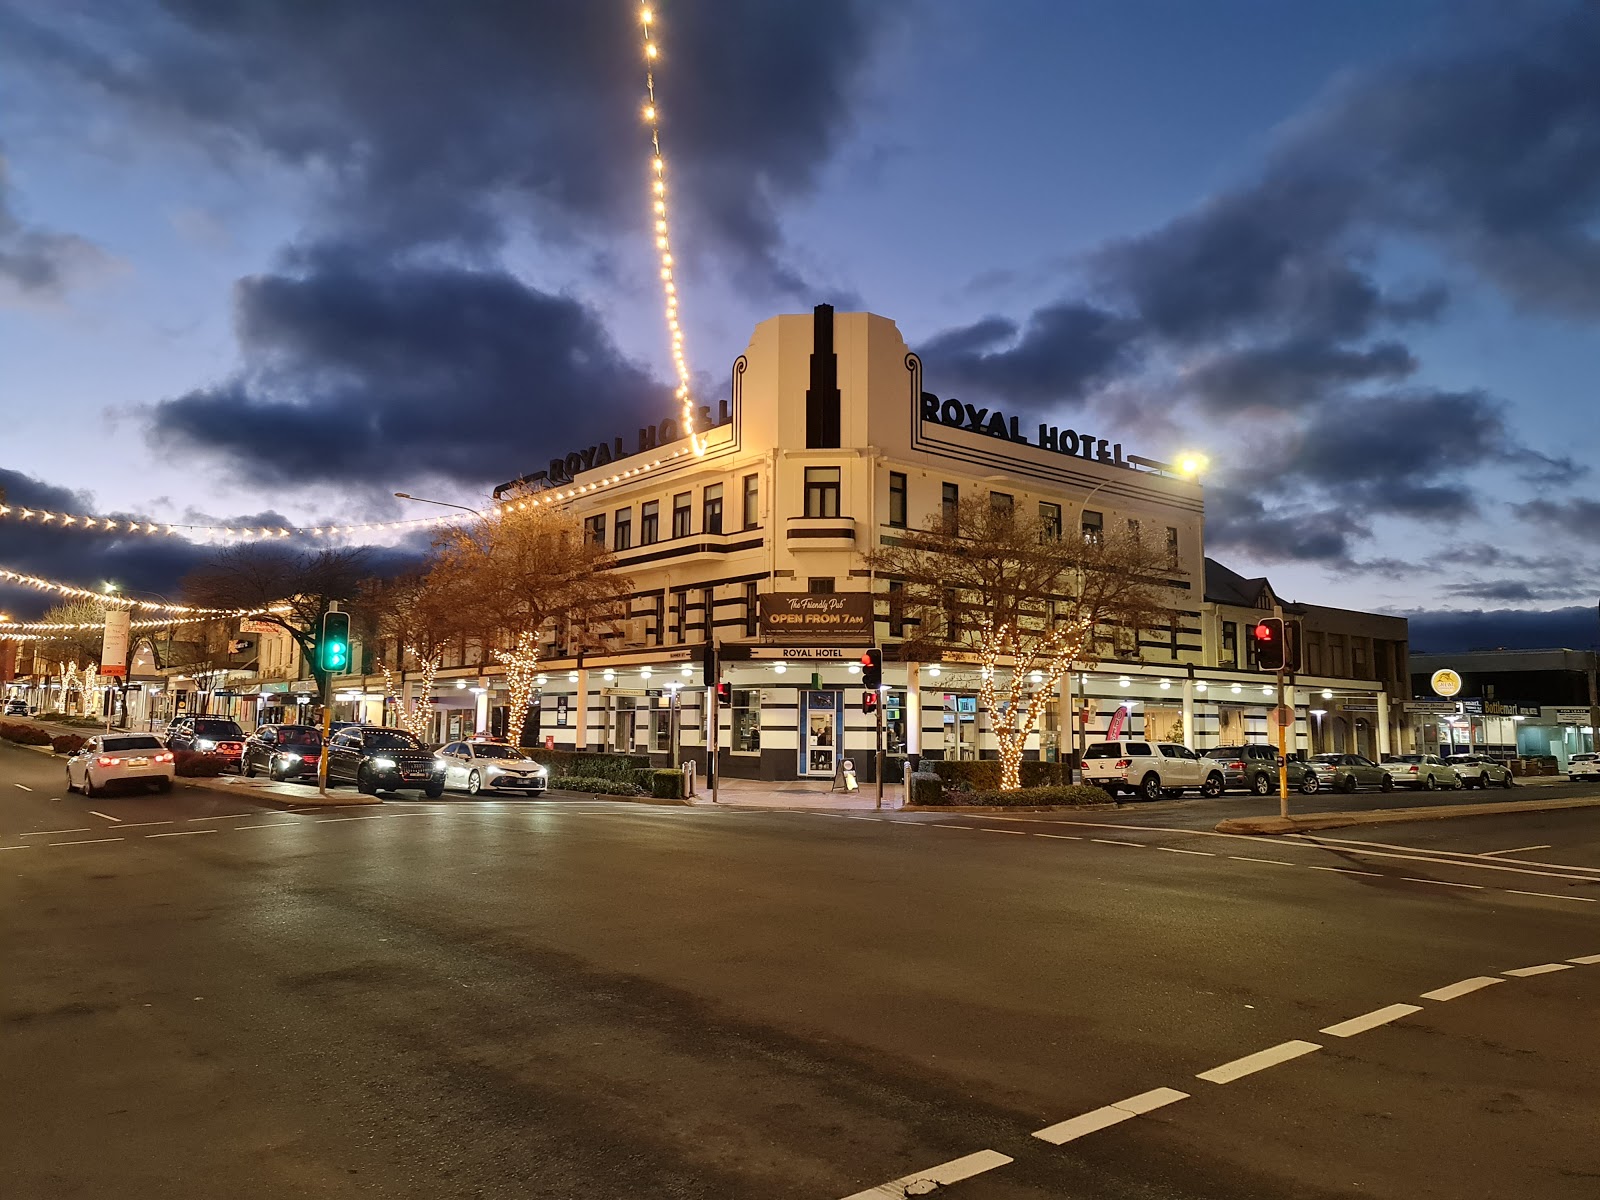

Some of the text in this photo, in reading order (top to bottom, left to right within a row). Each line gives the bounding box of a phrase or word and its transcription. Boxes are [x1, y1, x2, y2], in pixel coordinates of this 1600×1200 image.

[921, 391, 1140, 469] ROYAL HOTEL
[550, 437, 629, 482] ROYAL
[800, 598, 828, 613] Friendly
[769, 613, 803, 624] OPEN
[805, 613, 840, 624] FROM
[783, 649, 843, 657] ROYAL HOTEL
[1484, 700, 1518, 715] Bottlemart
